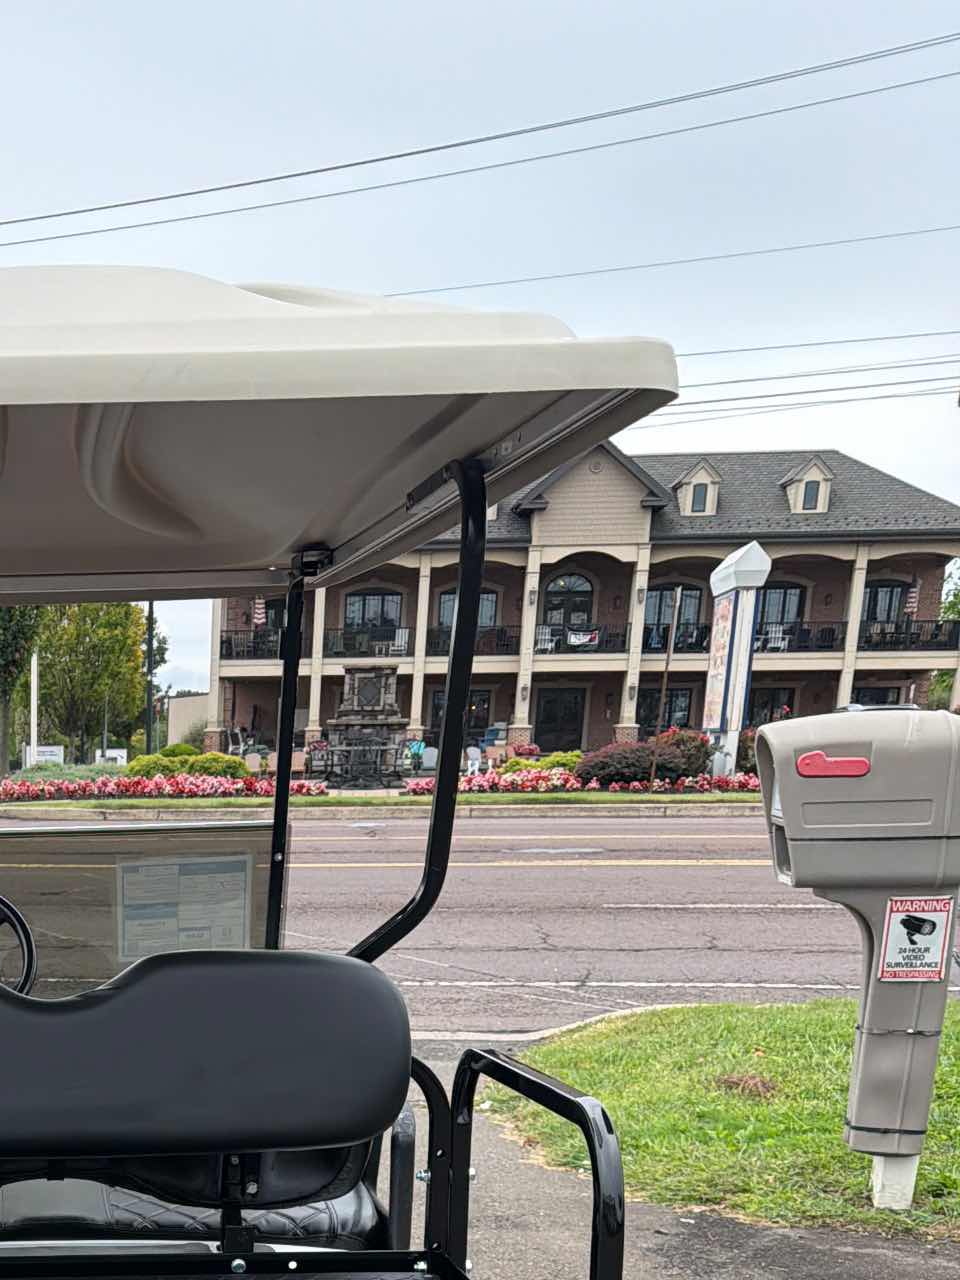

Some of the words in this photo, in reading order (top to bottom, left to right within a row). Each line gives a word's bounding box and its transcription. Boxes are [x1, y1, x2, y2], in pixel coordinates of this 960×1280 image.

[892, 900, 949, 912] WARNING
[885, 961, 939, 969] SURVEILLANCE
[895, 970, 940, 978] TRESPASSING
